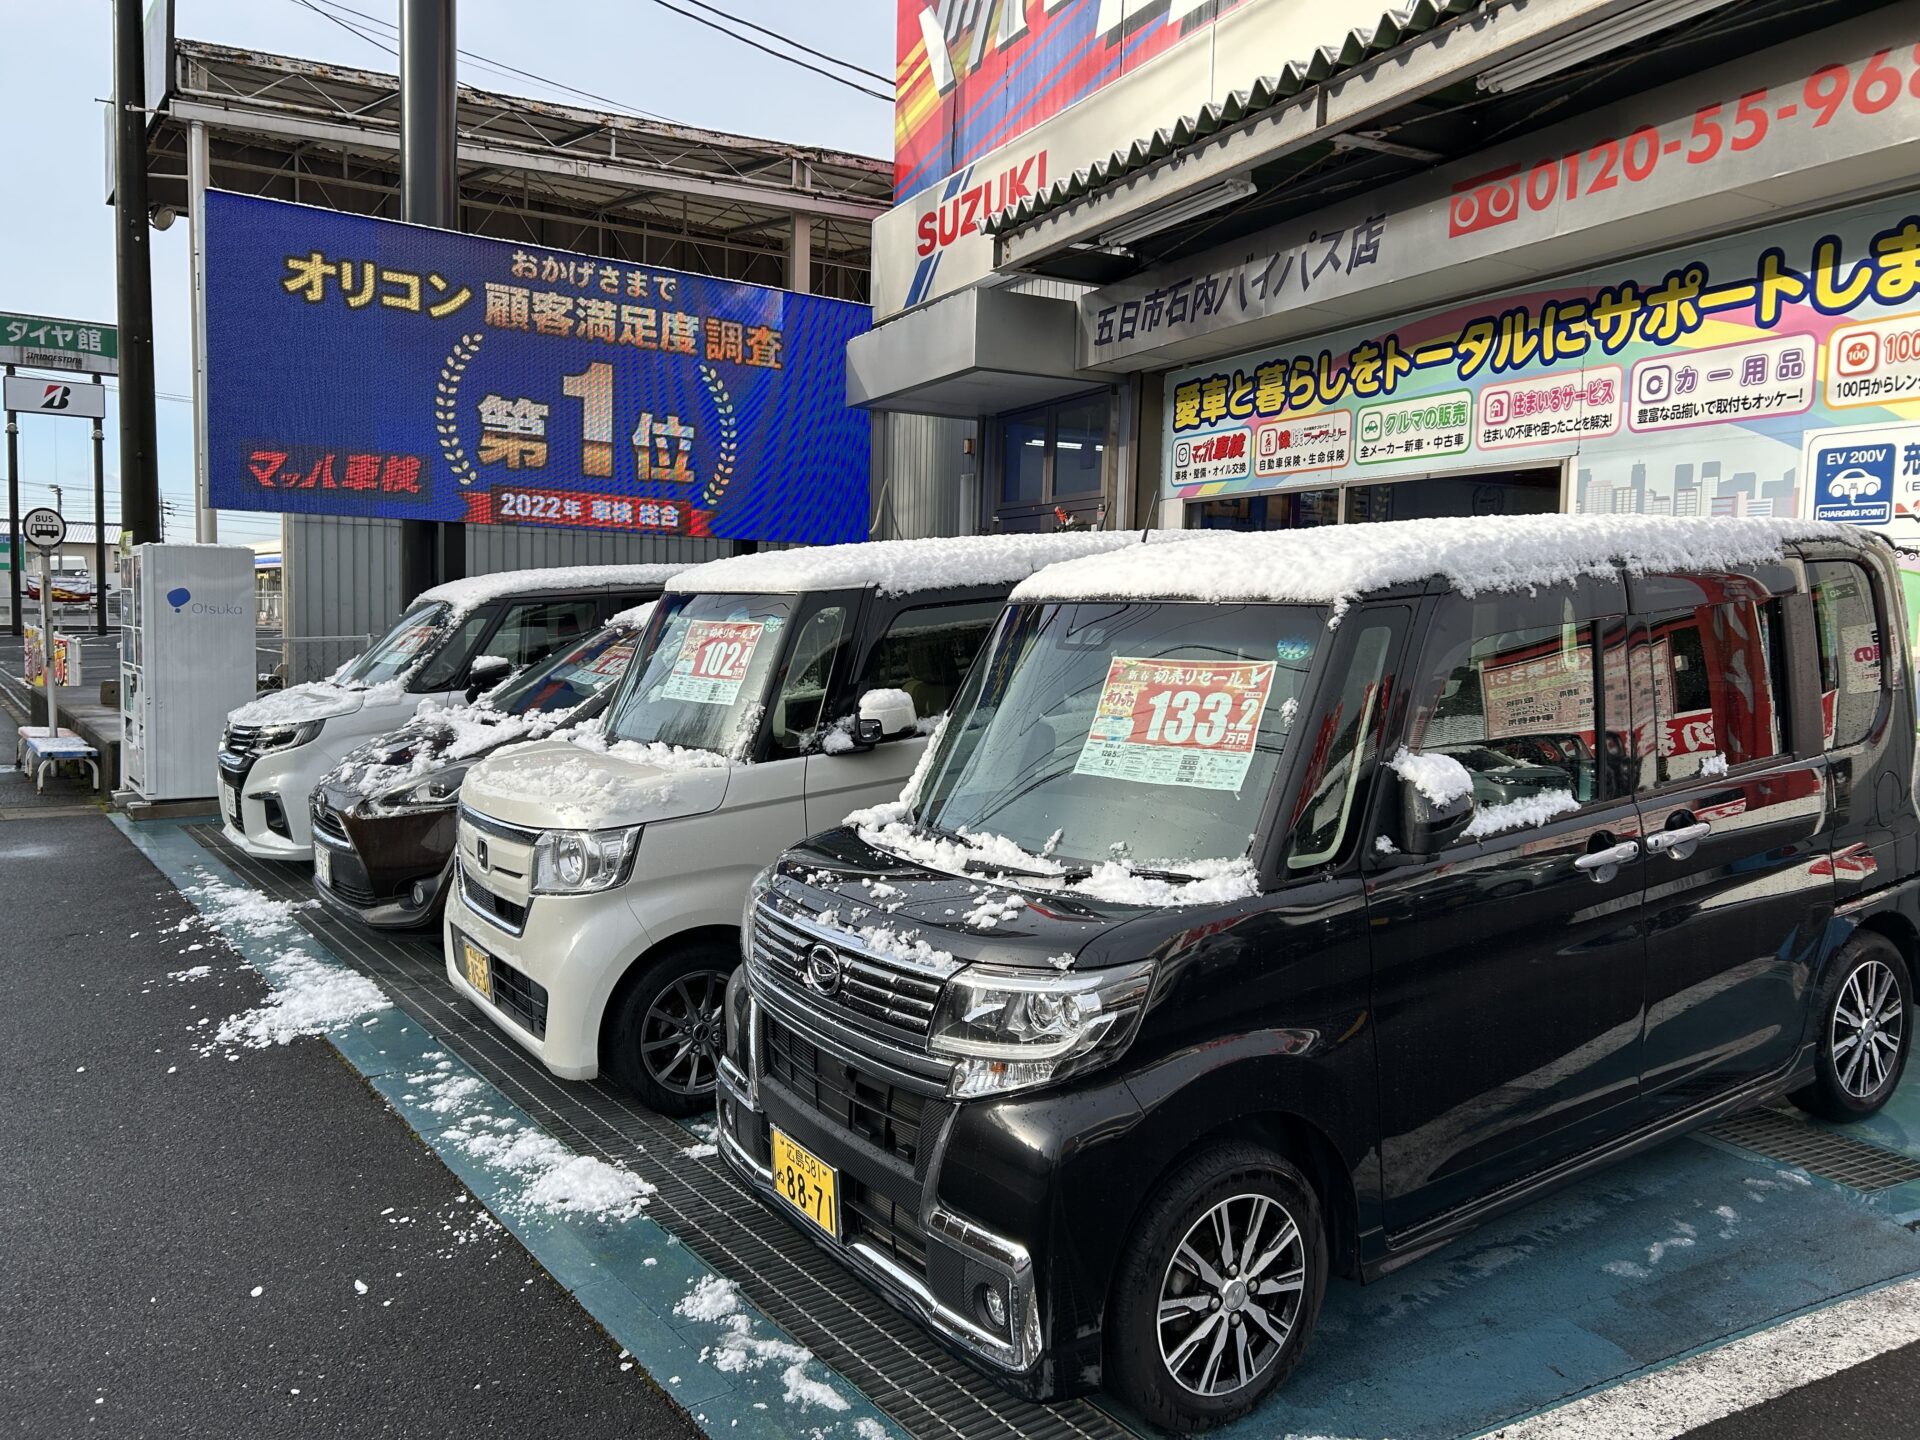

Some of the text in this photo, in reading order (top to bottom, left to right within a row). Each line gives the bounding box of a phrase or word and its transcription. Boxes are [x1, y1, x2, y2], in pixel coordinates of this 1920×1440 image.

[917, 150, 1047, 257] SUZUKI
[284, 252, 471, 318] オリコン
[512, 250, 677, 301] おかげさまで
[1094, 212, 1387, 346] 五日市石内バイパス店
[6, 321, 102, 352] タイヤ館
[1675, 348, 1805, 394] カー用品
[1513, 379, 1614, 418] 住まいるサービス
[478, 362, 695, 483] 第1位
[1385, 401, 1468, 436] クルマの販売
[1484, 413, 1612, 443] 住まいの不便や困ったことを解決!
[1192, 433, 1246, 463] マッハ車検
[1259, 449, 1345, 471] 自動車保険・生命保険
[1360, 433, 1464, 458] 全メーカー新車・中古車
[1826, 449, 1887, 465] EV 200V
[250, 451, 421, 493] マッハ車検
[1175, 462, 1246, 480] 車検・整備・オイル交換
[35, 515, 54, 523] BUS
[500, 493, 581, 519] 2022年
[1819, 507, 1886, 518] CHARGING POINT
[191, 603, 243, 615] Otsuka
[1153, 667, 1244, 687] 初売りセール
[1146, 690, 1259, 746] 133.2 万円
[787, 1165, 833, 1232] 88-71
